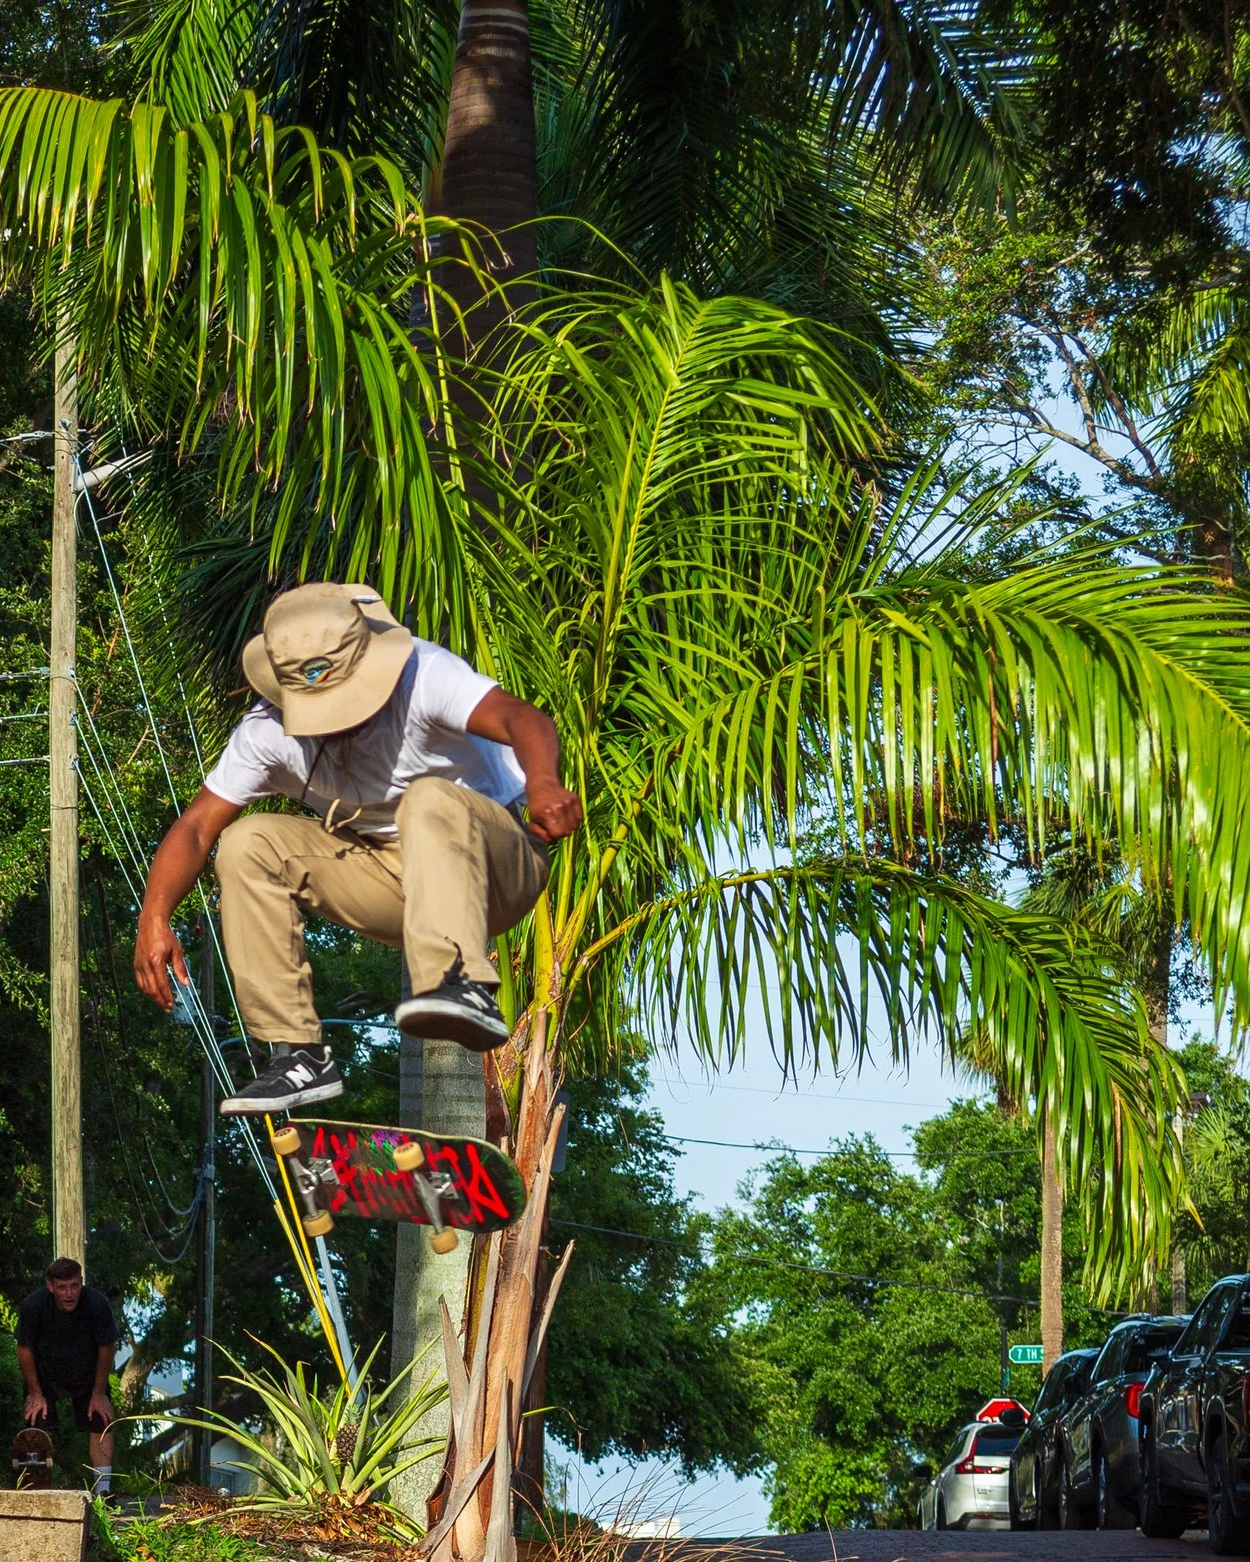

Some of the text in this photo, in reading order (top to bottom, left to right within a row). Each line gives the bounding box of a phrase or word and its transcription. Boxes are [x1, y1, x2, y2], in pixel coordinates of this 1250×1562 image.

[285, 1063, 314, 1089] N
[1017, 1348, 1022, 1360] 7
[1026, 1348, 1037, 1360] TH
